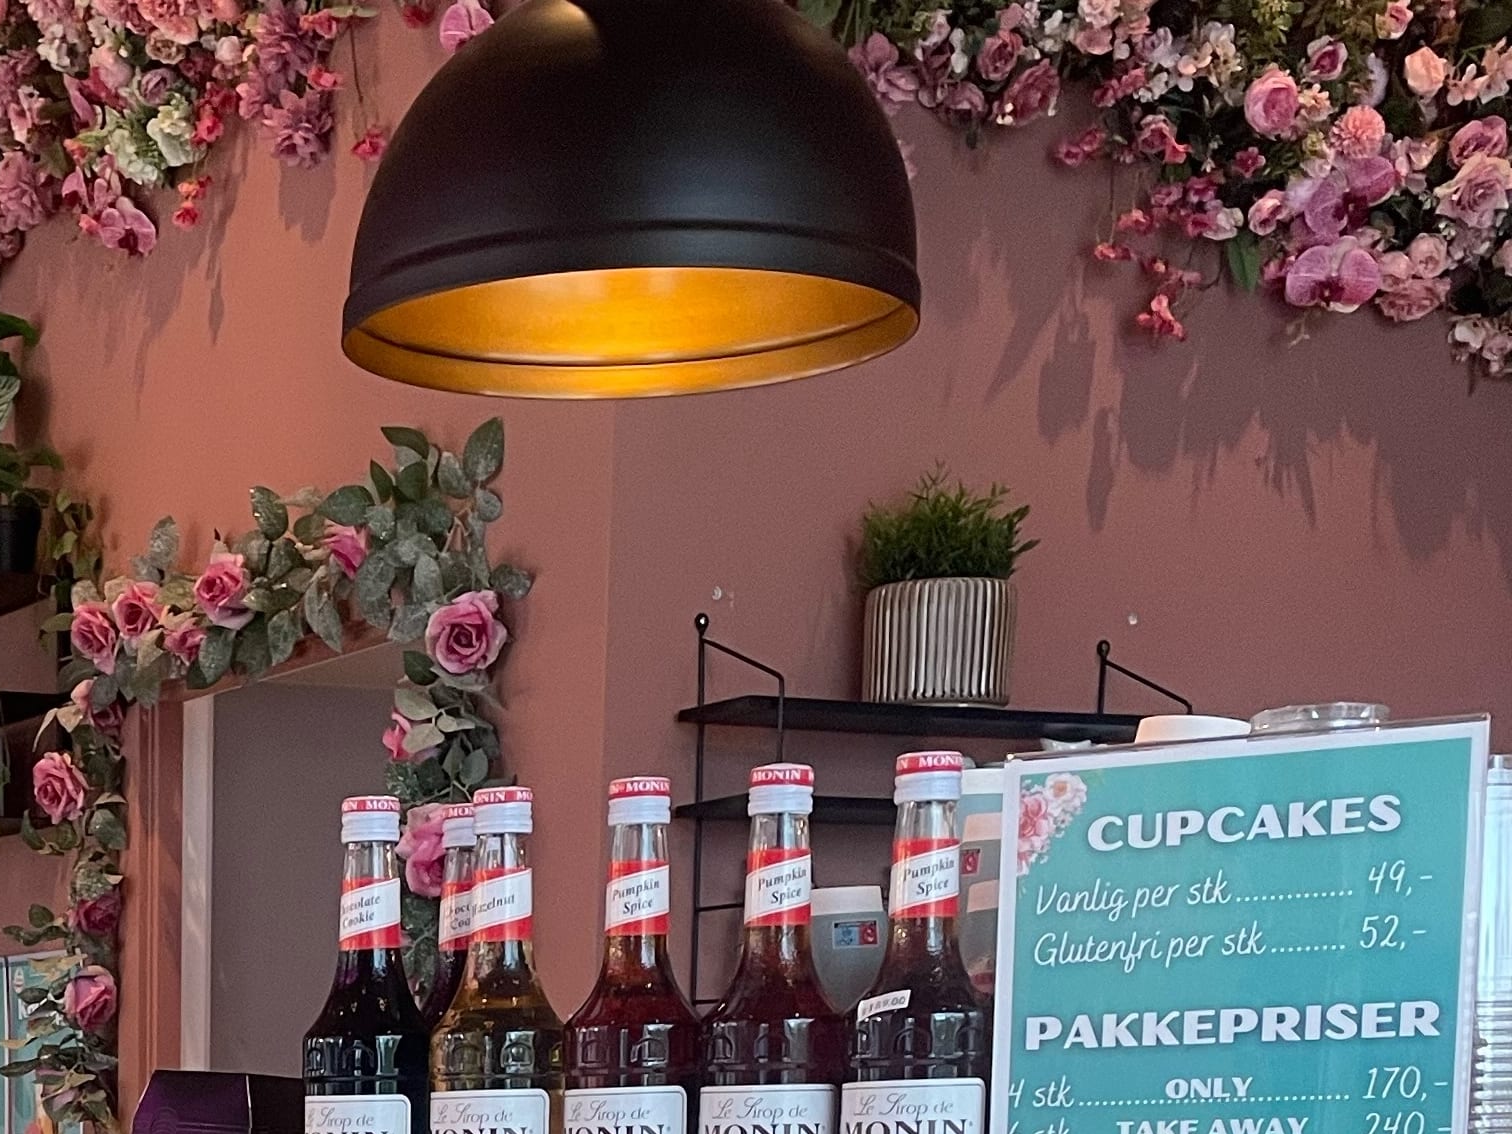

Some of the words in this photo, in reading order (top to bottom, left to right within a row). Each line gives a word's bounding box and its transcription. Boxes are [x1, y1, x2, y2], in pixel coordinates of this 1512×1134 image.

[752, 768, 801, 782] MONIN
[474, 790, 506, 803] ONIN
[1087, 794, 1402, 852] CUPCAKES
[758, 867, 807, 891] Pumpkin
[903, 857, 956, 882] Pumpkin
[612, 878, 660, 901] Pumpkin
[771, 886, 803, 905] Spice
[917, 877, 950, 896] Spice
[1035, 879, 1128, 922] Vanlig
[1132, 886, 1180, 918] per
[1368, 859, 1433, 897] 49,-
[623, 897, 653, 915] Spice
[1033, 930, 1163, 974] Glutenfri
[1165, 935, 1215, 968] per
[1359, 914, 1427, 951] 52,-
[1024, 1000, 1441, 1051] PAKKEPRISER
[1007, 1078, 1026, 1110] 4
[1165, 1077, 1254, 1100] ONLY
[1362, 1066, 1449, 1102] 170,-
[451, 1103, 489, 1130] Sirop
[494, 1107, 513, 1122] de
[712, 1098, 731, 1120] Le
[736, 1096, 782, 1124] Sirop
[789, 1102, 808, 1119] de
[854, 1096, 874, 1117] Le
[879, 1093, 928, 1122] Sirop
[934, 1099, 953, 1114] de
